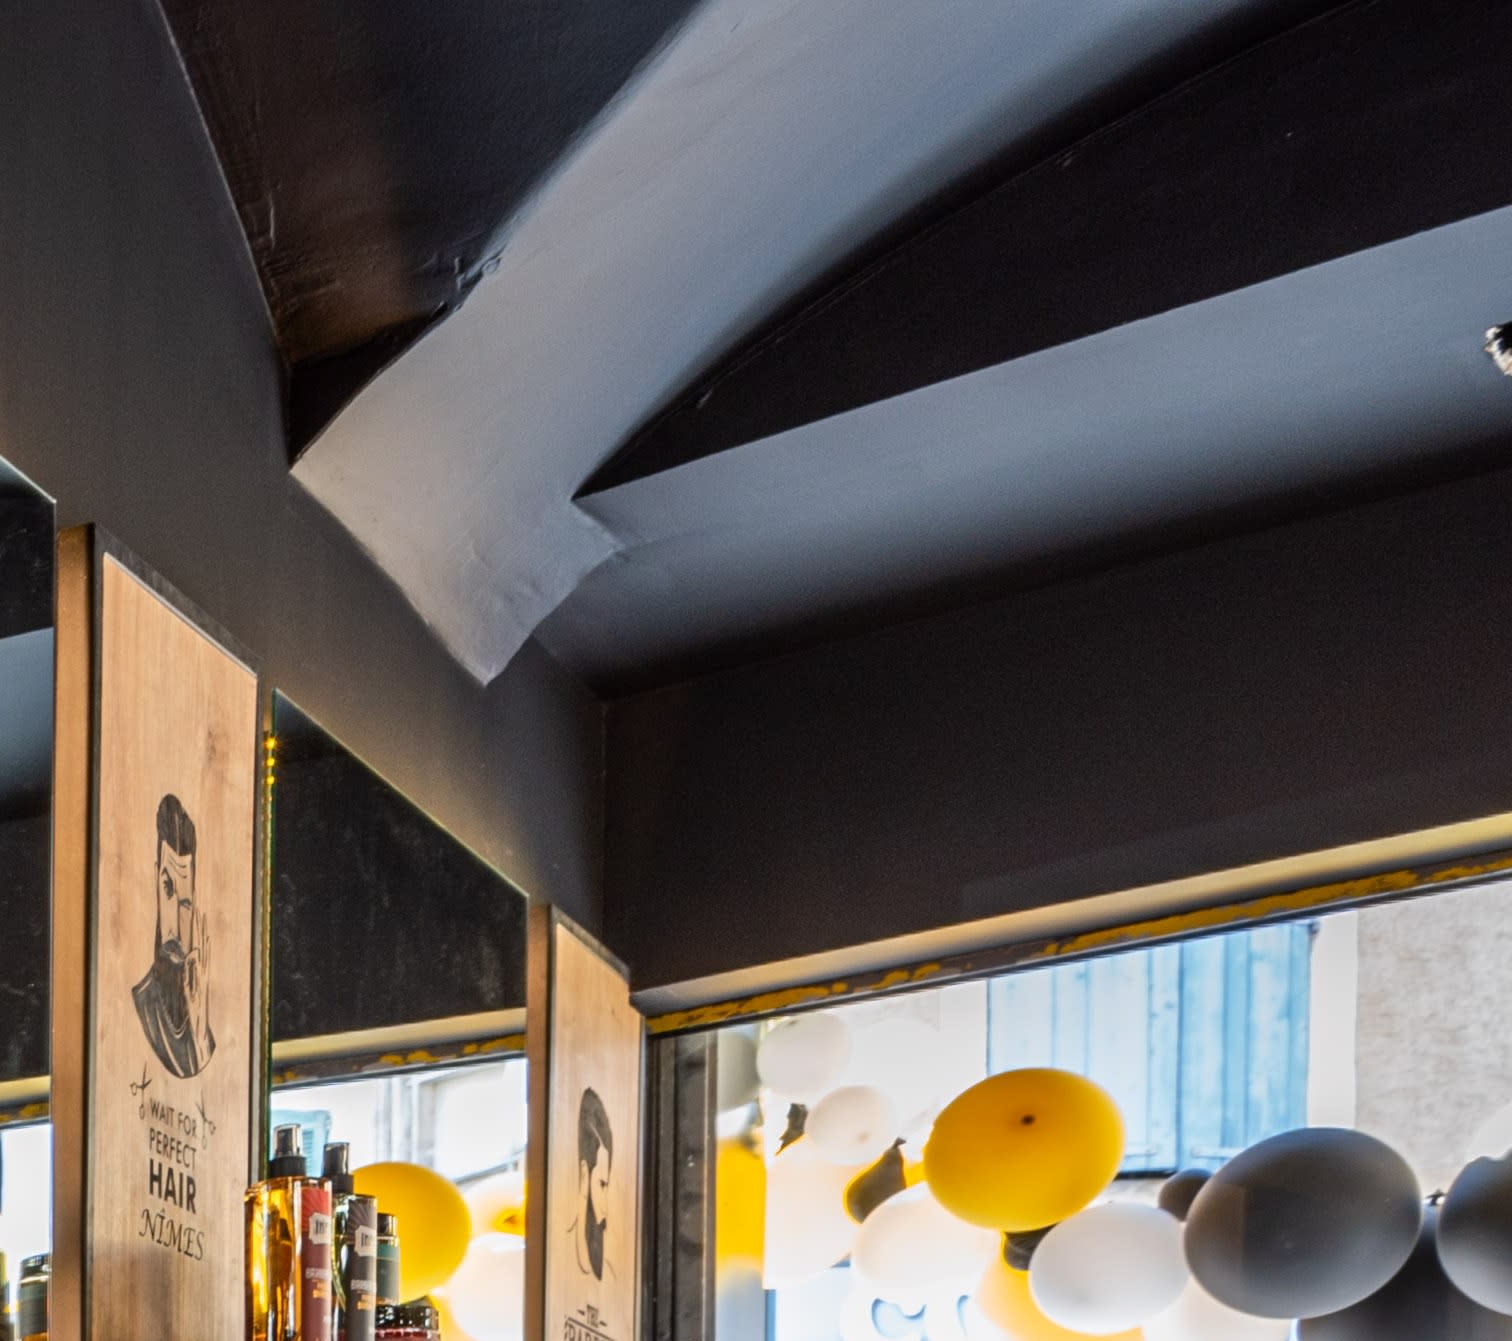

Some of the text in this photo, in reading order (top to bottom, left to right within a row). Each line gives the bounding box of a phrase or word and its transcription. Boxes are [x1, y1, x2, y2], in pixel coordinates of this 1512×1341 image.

[150, 1097, 197, 1138] WAIT FOR
[148, 1127, 197, 1170] PERFECT
[148, 1157, 197, 1215] HAIR
[138, 1207, 205, 1262] NÎMES
